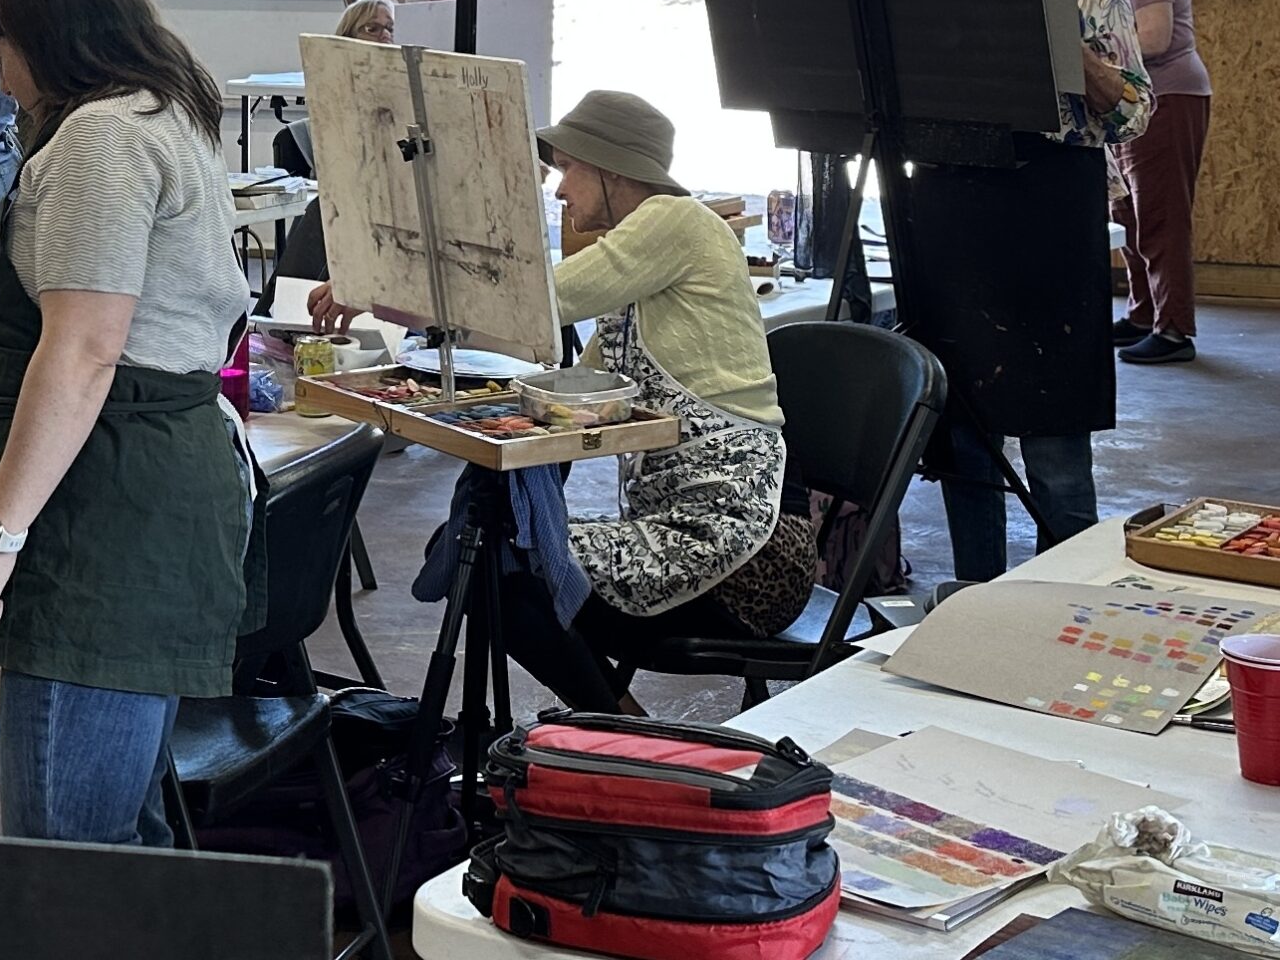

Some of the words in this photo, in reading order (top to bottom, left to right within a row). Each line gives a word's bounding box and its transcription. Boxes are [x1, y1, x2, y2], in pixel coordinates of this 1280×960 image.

[461, 66, 488, 89] Holly
[1176, 882, 1221, 899] KIRKLAND
[1194, 897, 1228, 916] Wipes
